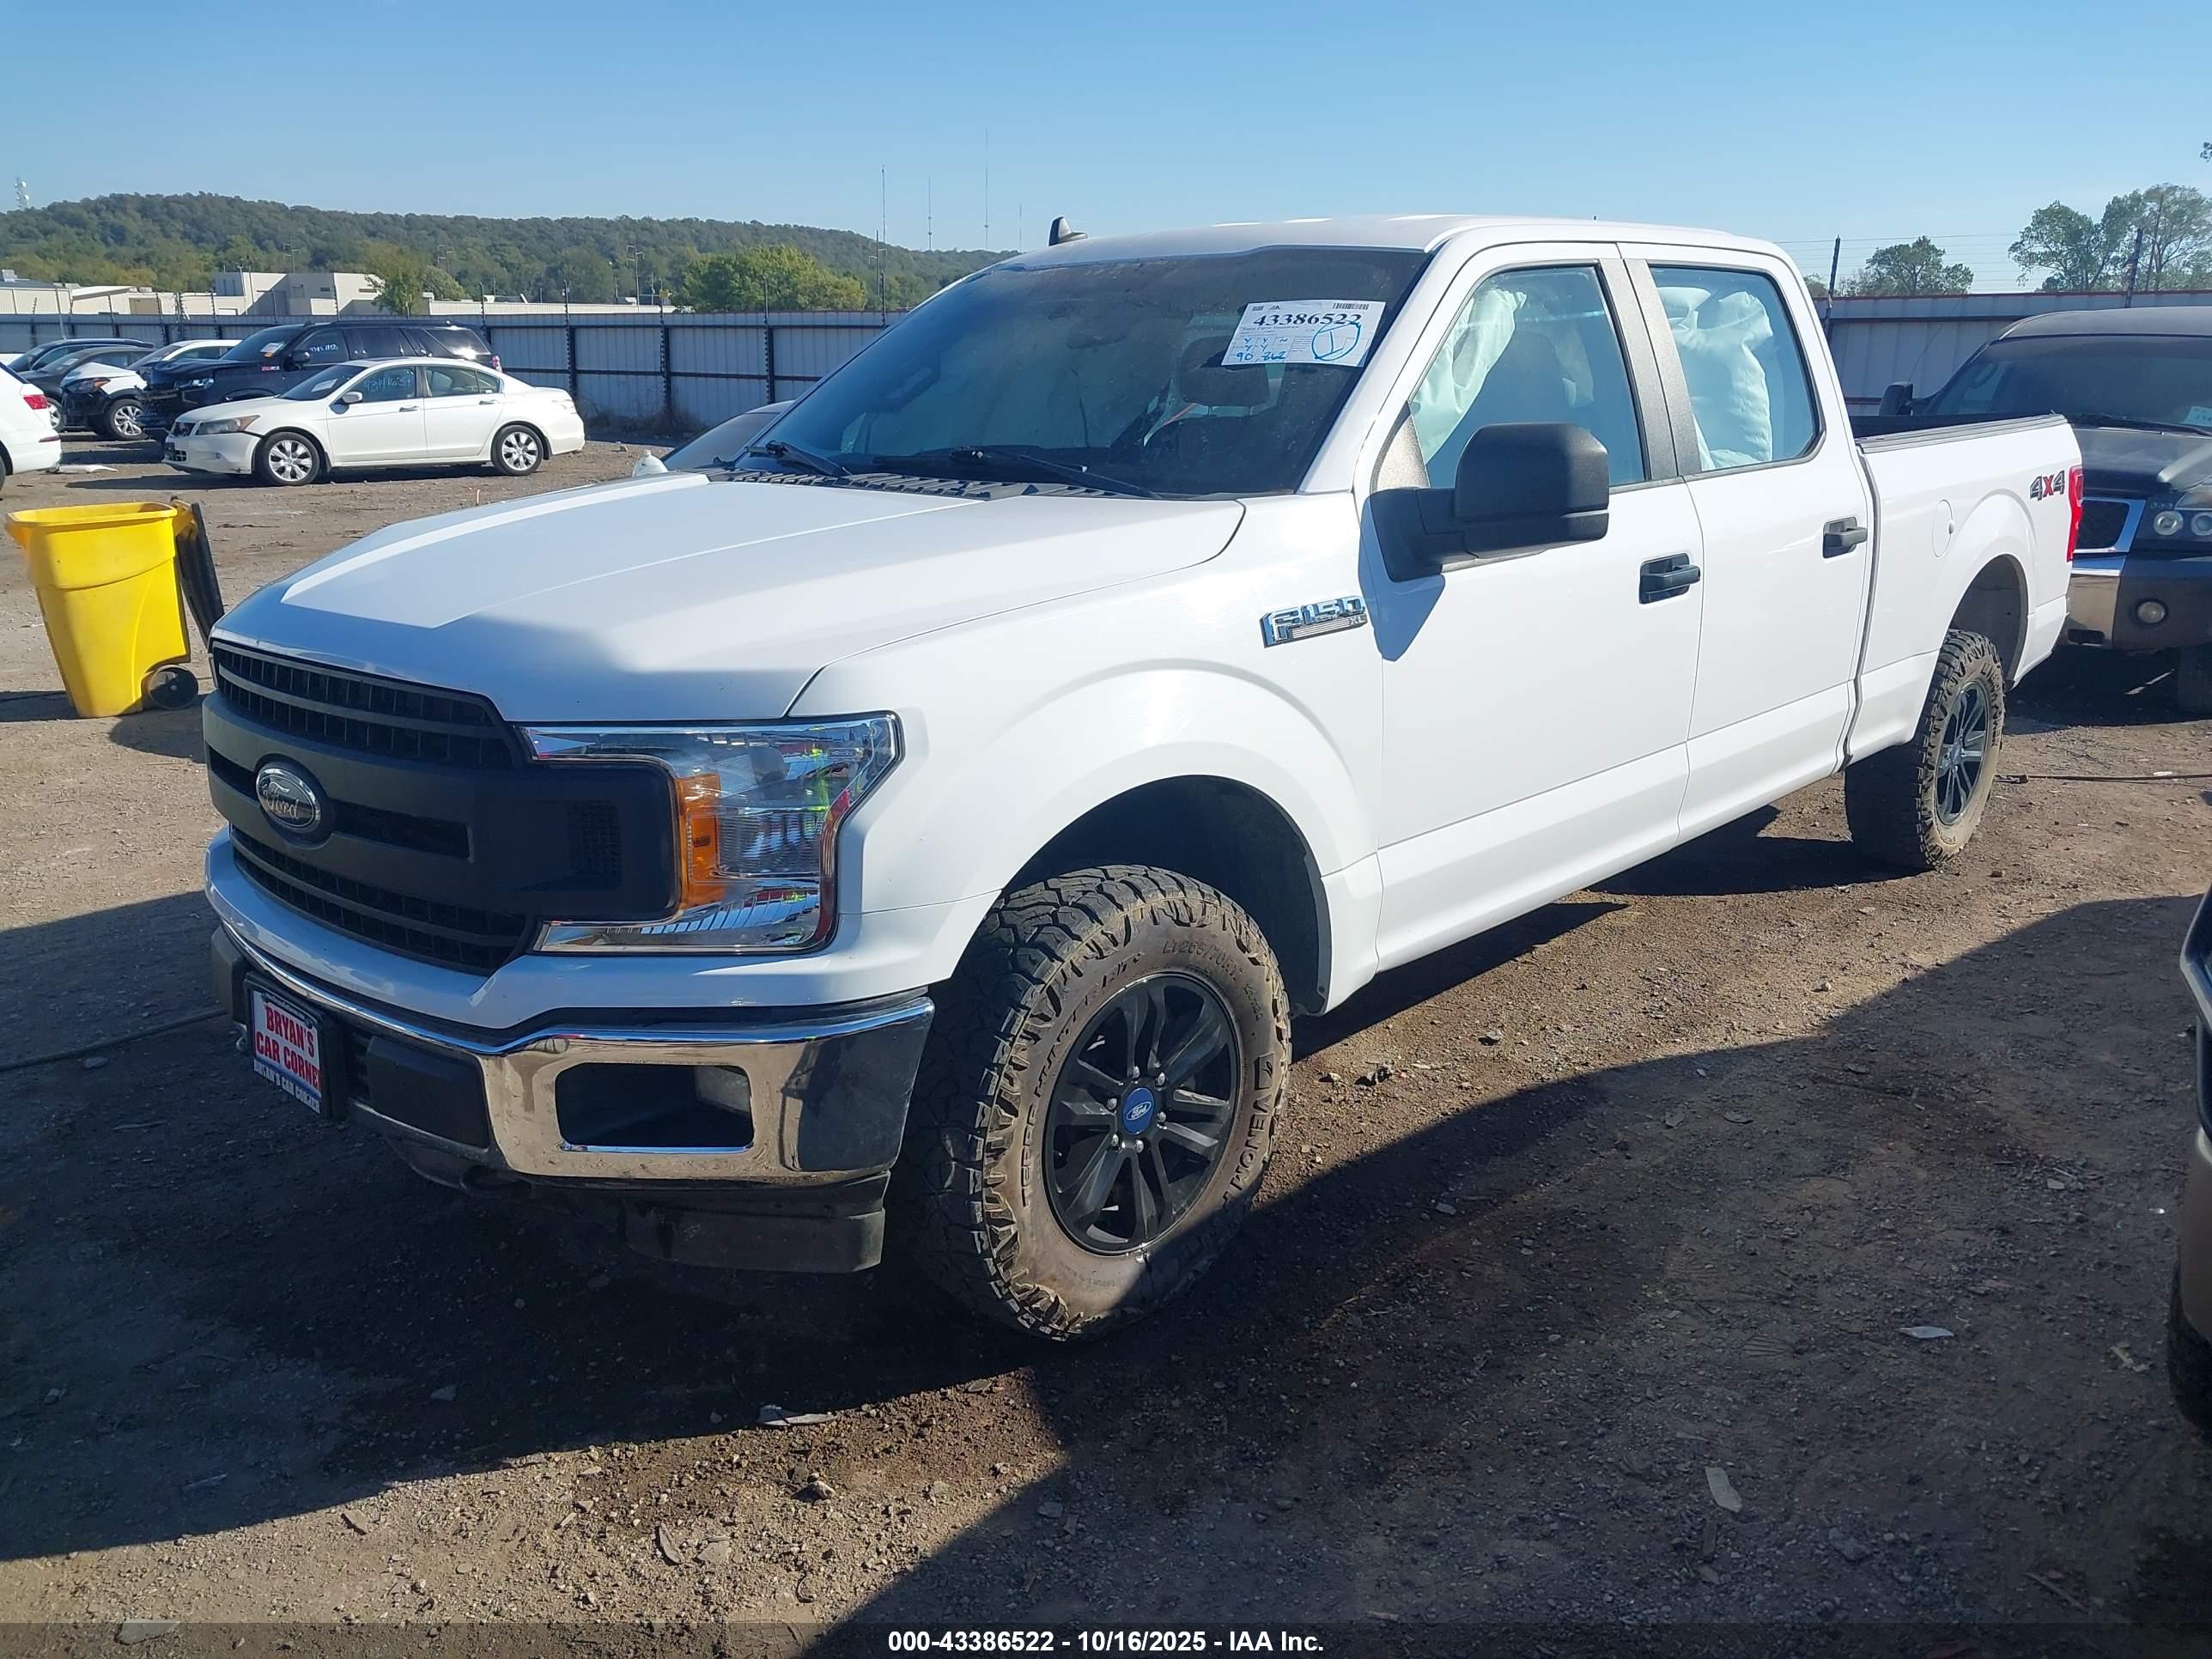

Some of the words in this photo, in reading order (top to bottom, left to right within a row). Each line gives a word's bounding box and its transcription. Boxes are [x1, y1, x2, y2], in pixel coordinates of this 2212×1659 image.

[1253, 313, 1362, 326] 43386522
[1348, 616, 1364, 627] XL
[257, 1031, 281, 1064] CAR
[264, 1006, 315, 1059] BRYAN'S
[1230, 1093, 1273, 1191] VENOM
